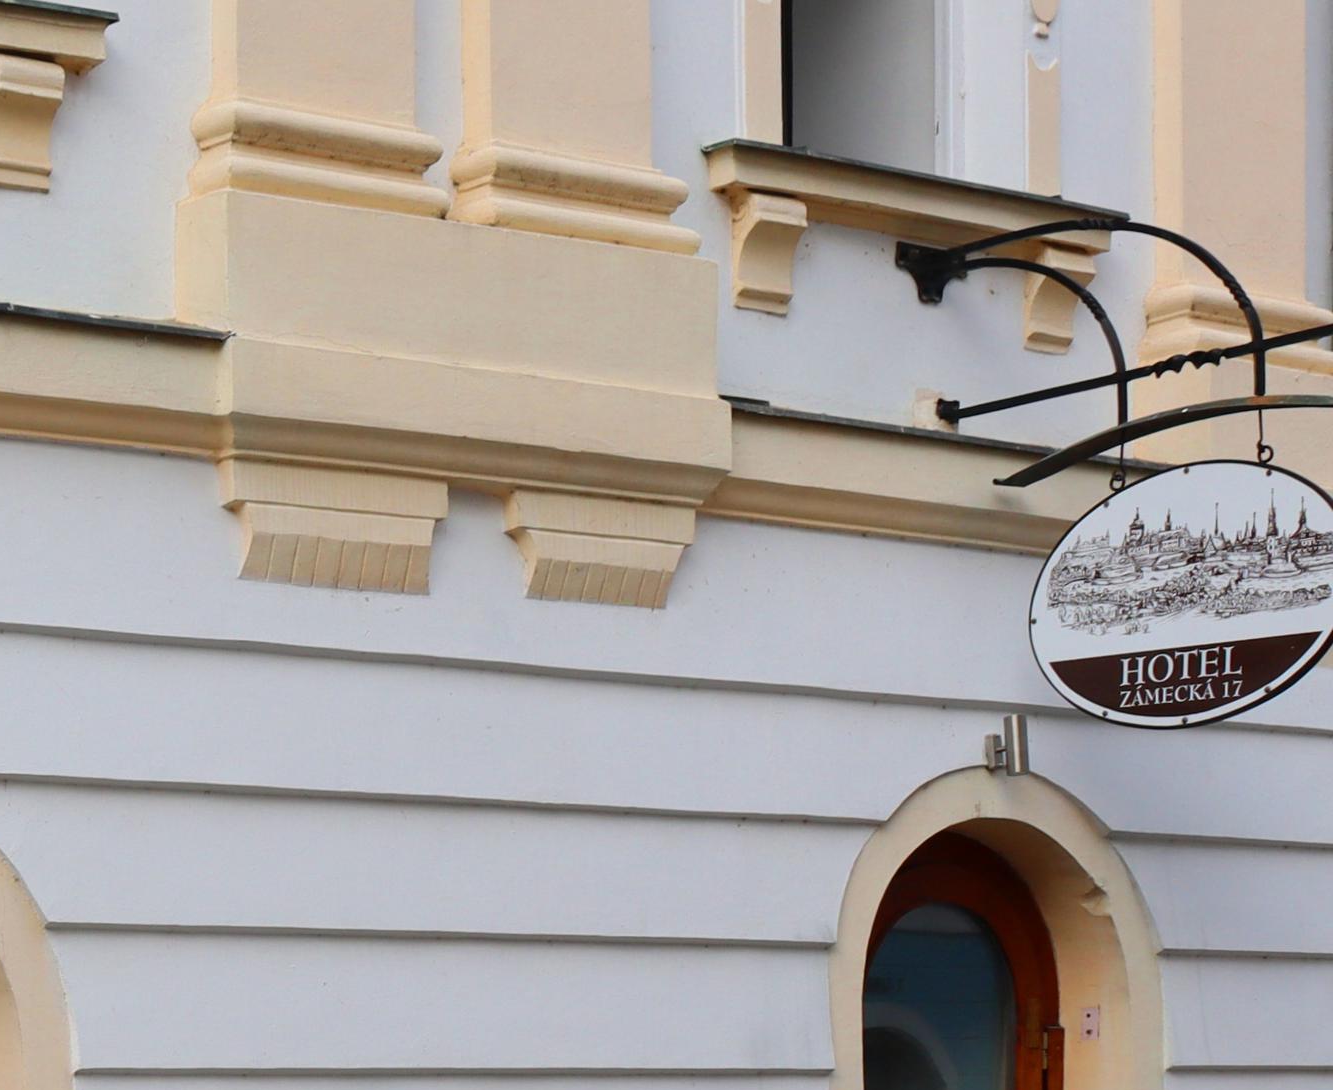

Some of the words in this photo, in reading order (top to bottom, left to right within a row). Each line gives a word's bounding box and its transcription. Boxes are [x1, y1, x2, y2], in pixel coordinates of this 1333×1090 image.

[1119, 646, 1244, 687] HOTEL
[1119, 678, 1216, 708] ZÁMECKÁ
[1222, 680, 1244, 698] 17
